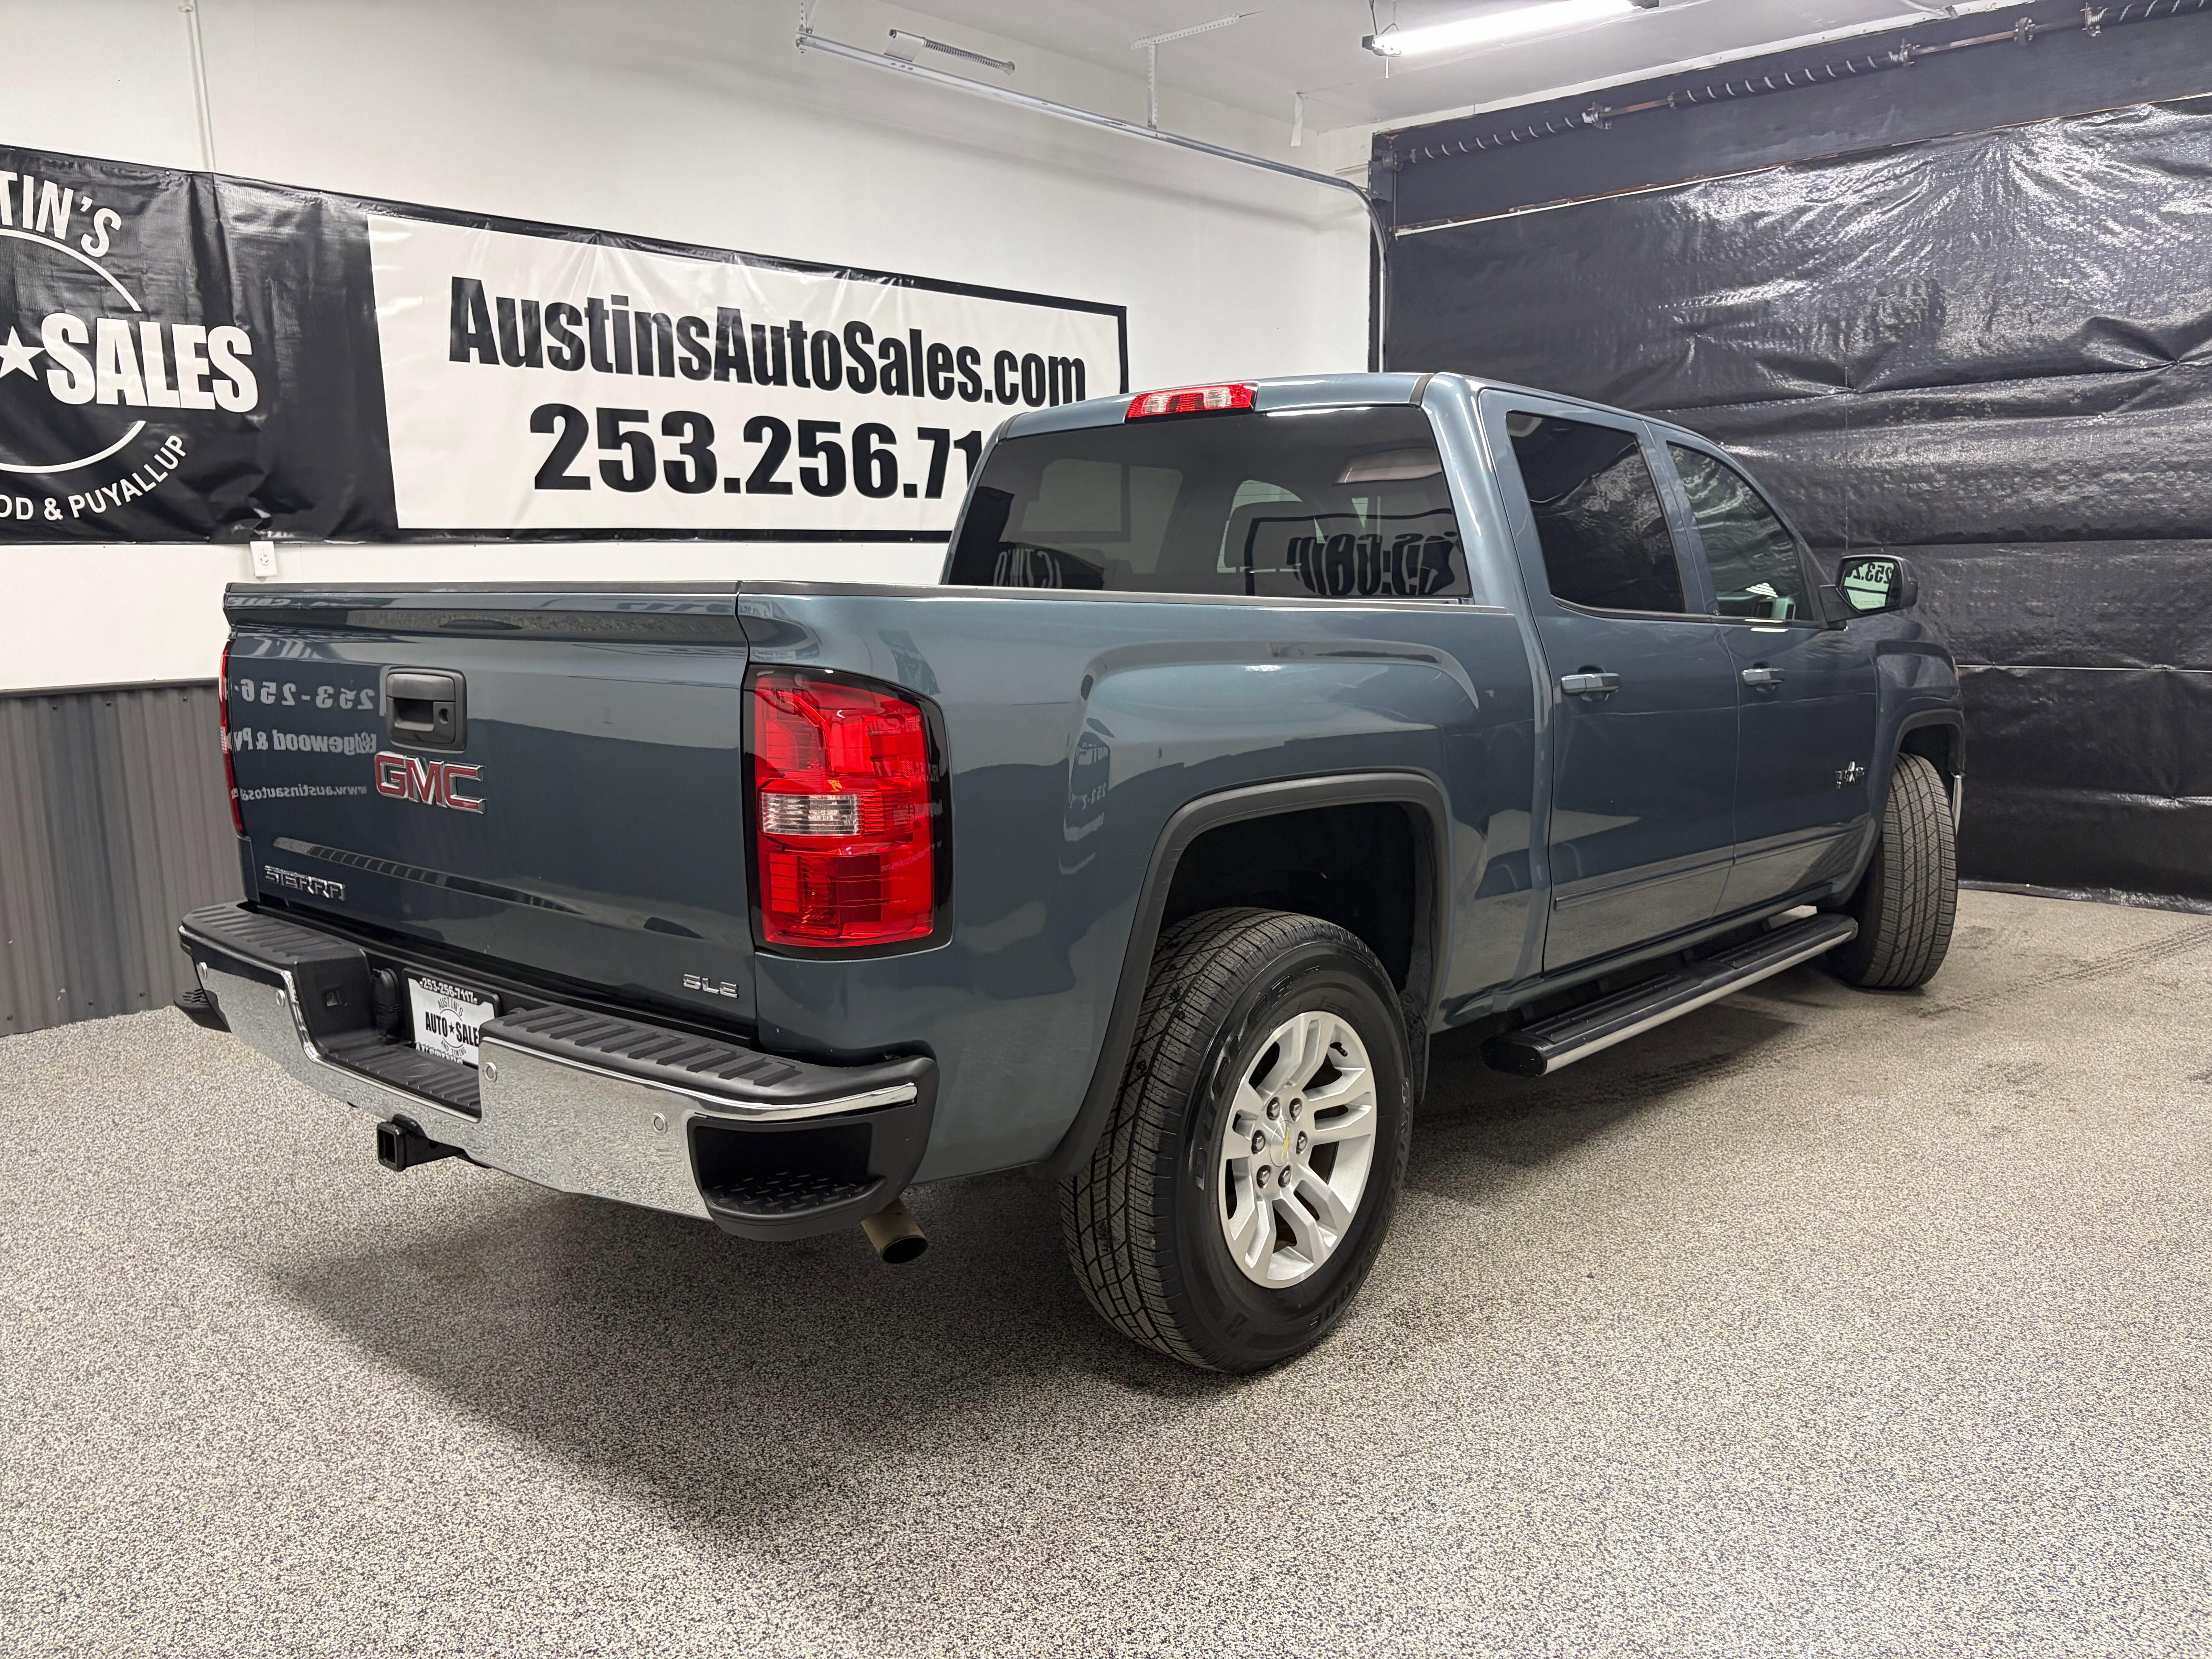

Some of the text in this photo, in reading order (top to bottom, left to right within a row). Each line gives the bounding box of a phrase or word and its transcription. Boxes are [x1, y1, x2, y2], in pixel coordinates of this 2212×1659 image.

[449, 276, 1086, 407] AustinsAutoSales.com
[41, 313, 258, 412] SALES
[529, 403, 982, 500] 253.256.71
[44, 498, 63, 520] &
[68, 435, 186, 518] PUYALLUP
[374, 751, 486, 814] GMC
[264, 866, 345, 901] SIERRA
[422, 977, 474, 1003] 253-256-7117
[684, 974, 737, 998] SLE
[438, 997, 464, 1017] AUSTIN'S
[425, 1011, 479, 1046] AUTO SALE
[452, 1046, 467, 1058] TOWING
